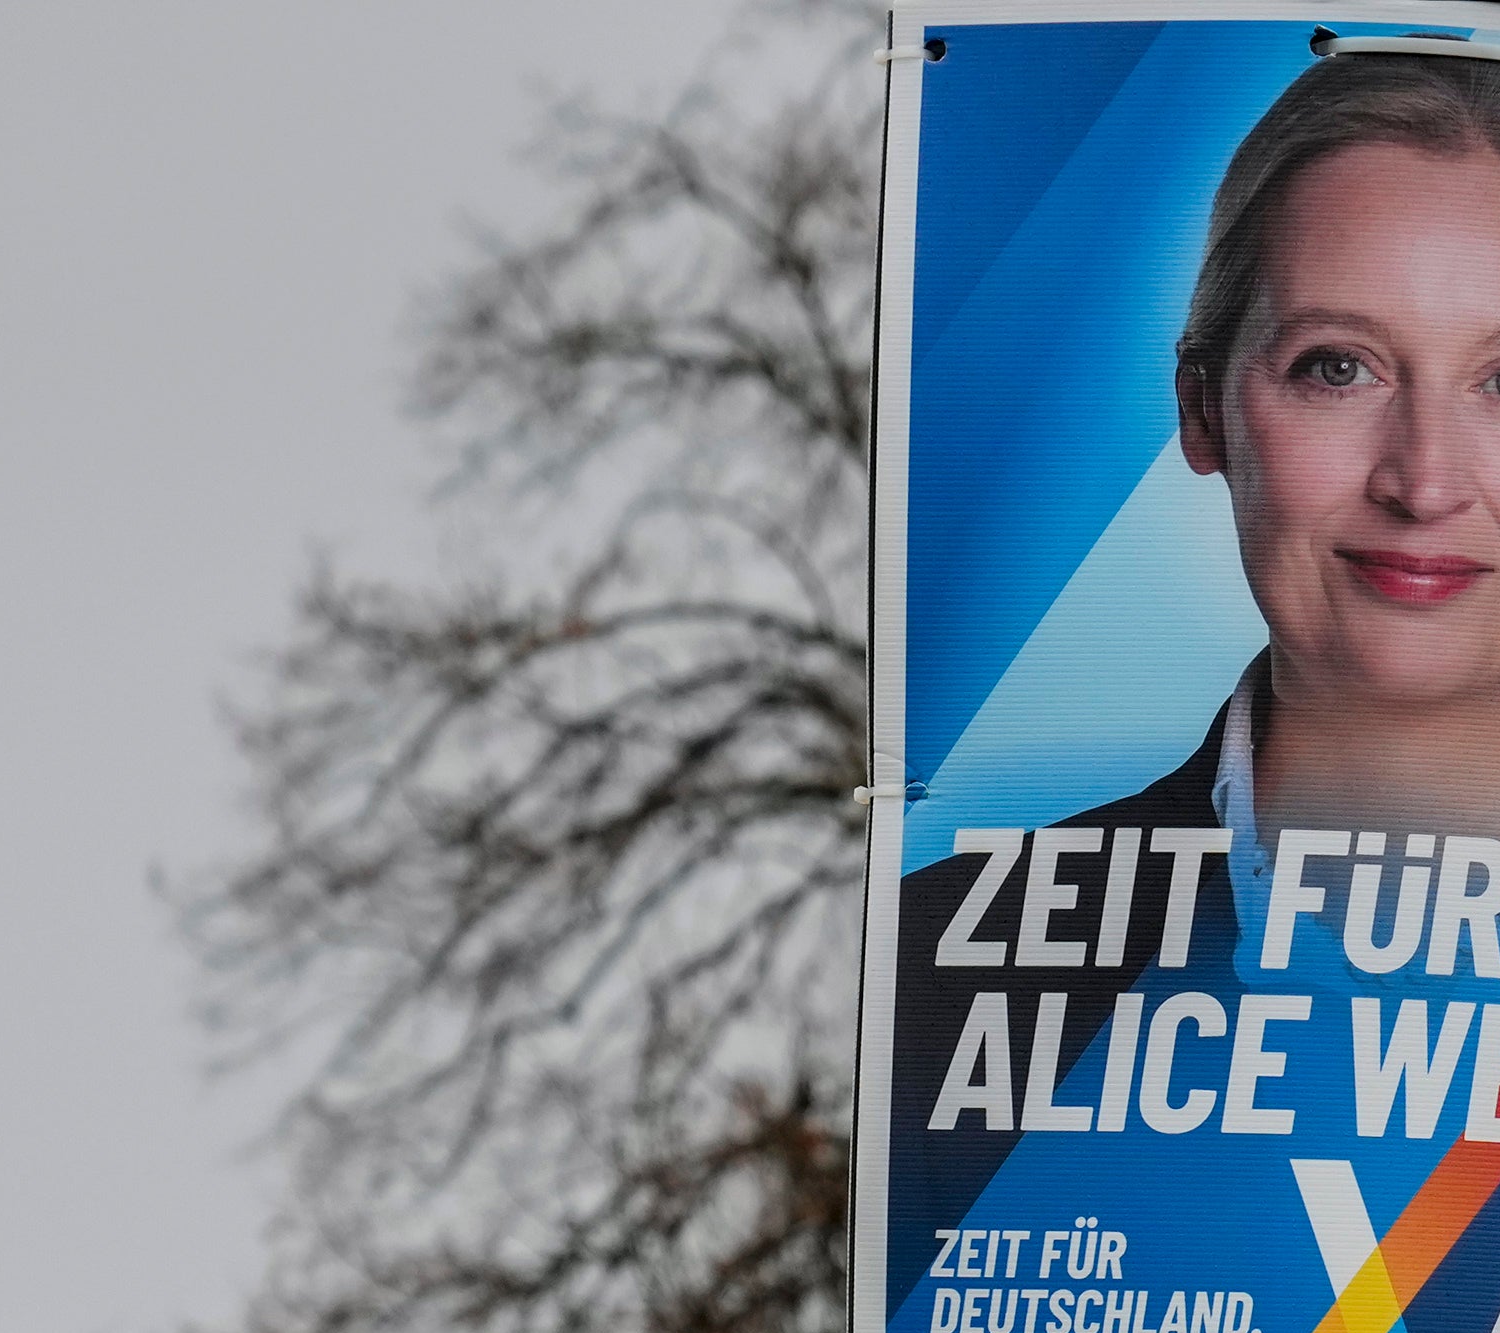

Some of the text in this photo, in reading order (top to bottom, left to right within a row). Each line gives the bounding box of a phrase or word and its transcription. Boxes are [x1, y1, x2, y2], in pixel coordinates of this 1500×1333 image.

[934, 827, 1234, 968] ZEIT
[927, 991, 1313, 1135] ALICE
[929, 1216, 1128, 1281] ZEIT FÜR
